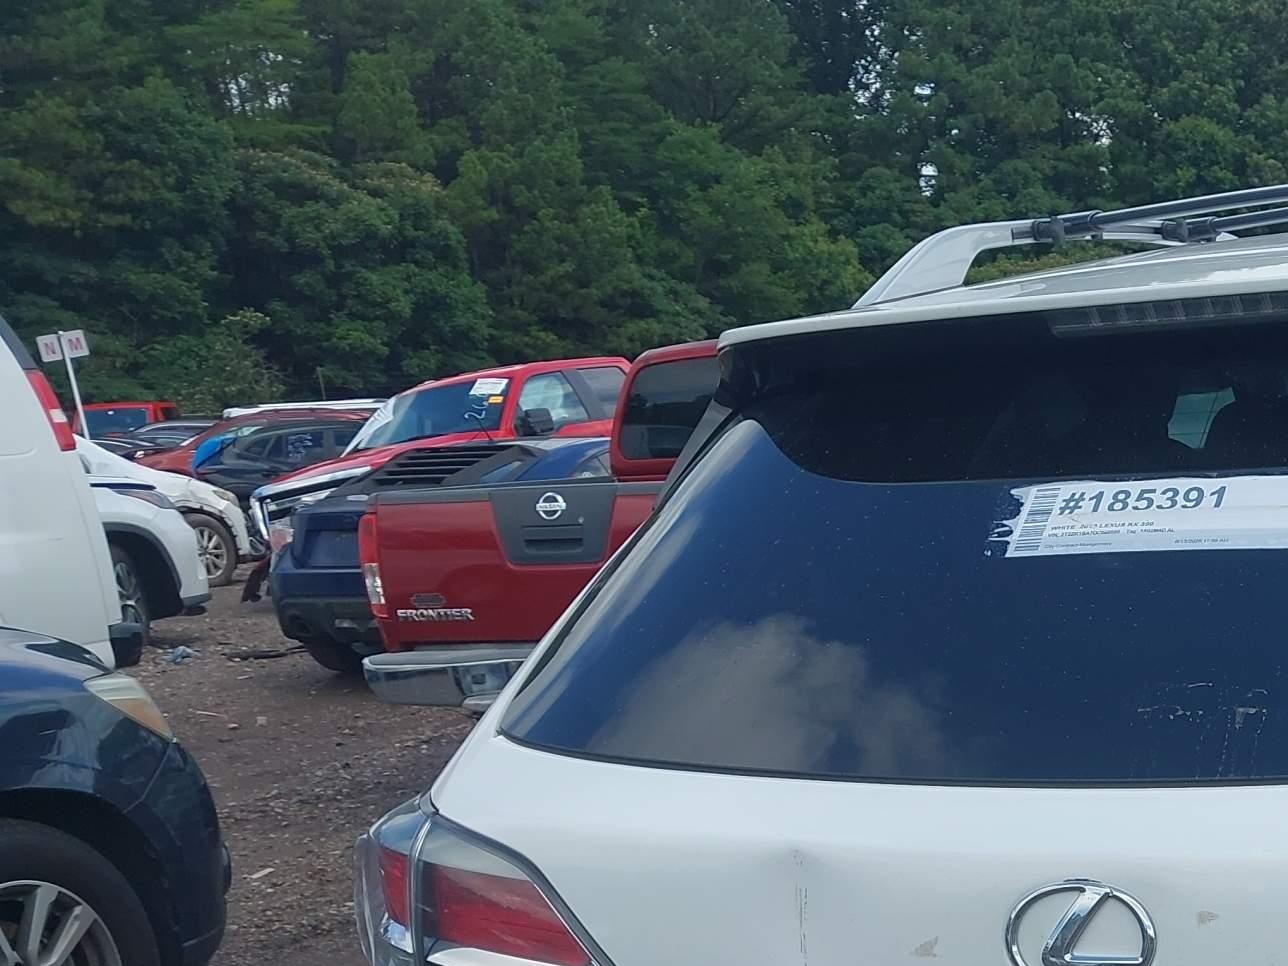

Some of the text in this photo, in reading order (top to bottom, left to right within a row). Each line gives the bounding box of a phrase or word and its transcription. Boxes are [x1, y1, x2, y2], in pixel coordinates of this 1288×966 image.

[44, 342, 56, 355] N
[68, 337, 84, 352] M
[1058, 485, 1227, 515] #185391
[396, 608, 475, 620] FRONTIER
